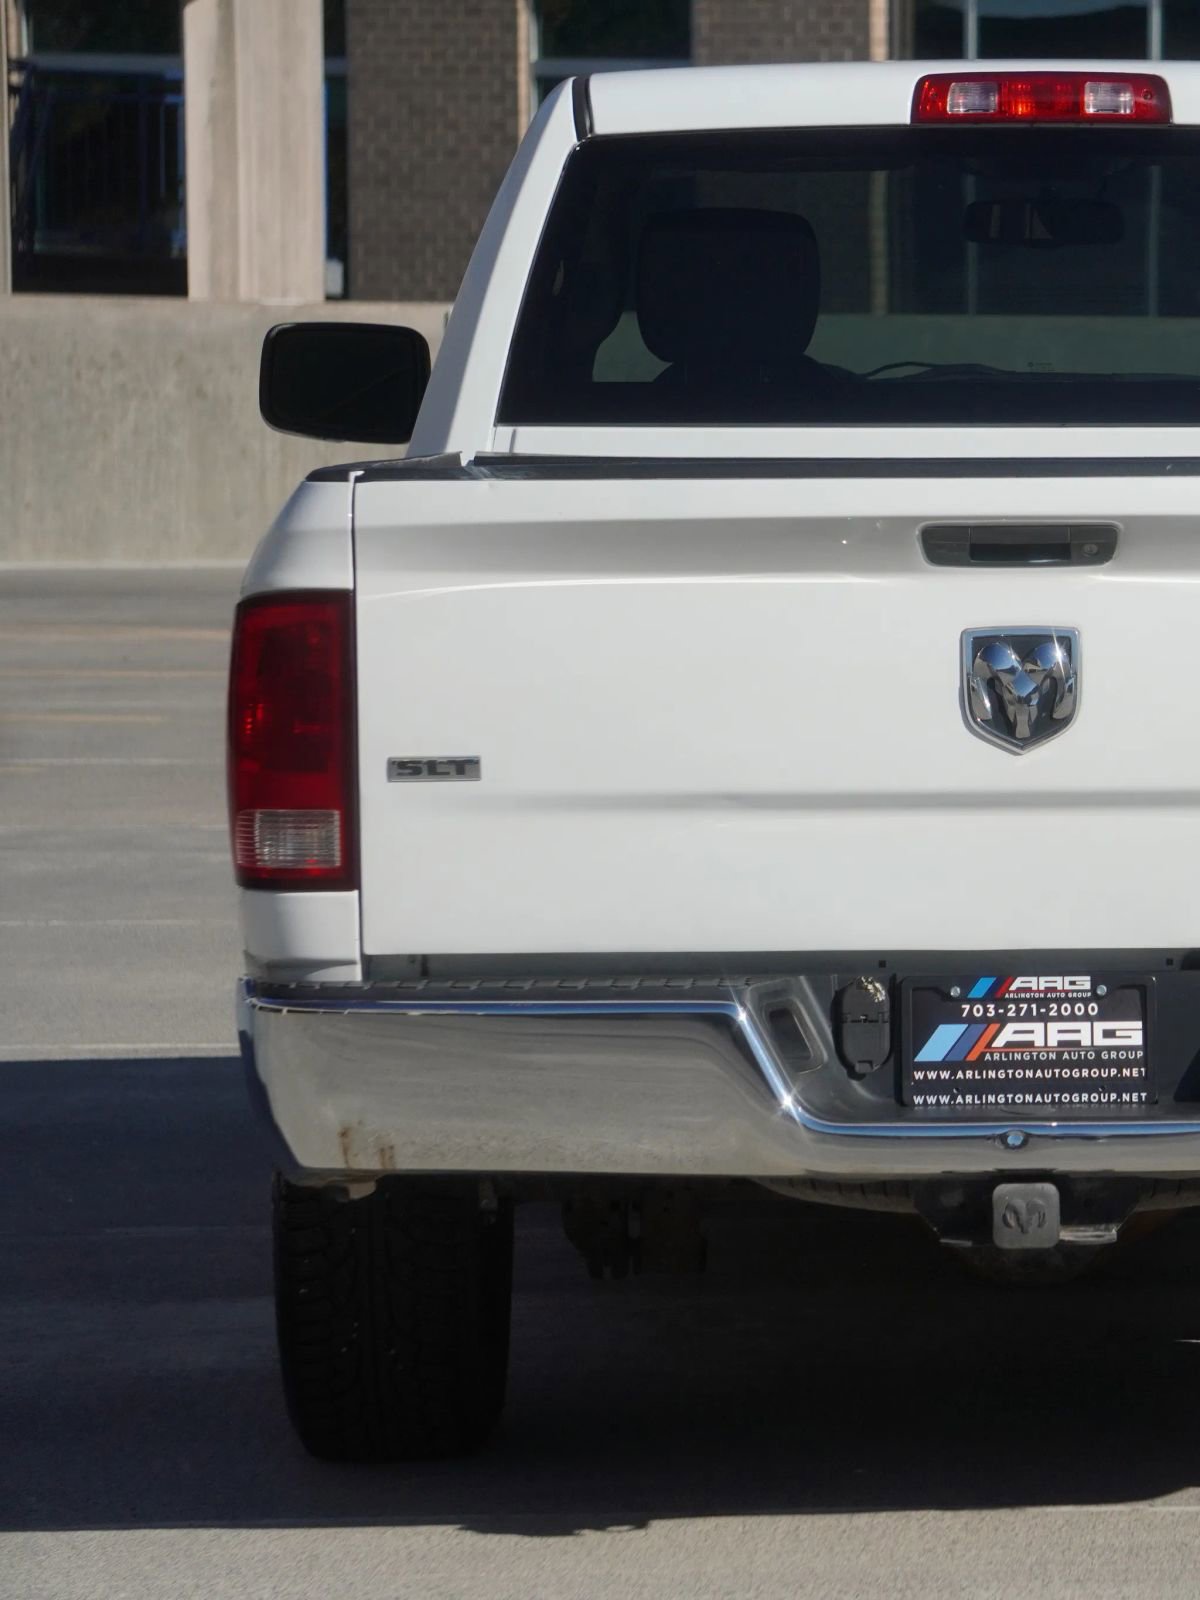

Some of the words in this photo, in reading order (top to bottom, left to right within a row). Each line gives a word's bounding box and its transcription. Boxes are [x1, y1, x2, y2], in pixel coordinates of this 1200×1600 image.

[392, 759, 479, 776] SLT
[1009, 975, 1091, 991] AAG
[961, 1002, 1099, 1017] 703-271-2000
[991, 1021, 1143, 1048] AAG
[984, 1052, 1057, 1061] ARLINGTON
[1062, 1051, 1096, 1061] AUTO
[1101, 1050, 1144, 1060] GROUP
[913, 1067, 1146, 1080] WWW.ARLINGTONAUTOGROUP.NET
[913, 1092, 1148, 1105] WWW.ARLINGTONAUTOGROUP.NET
